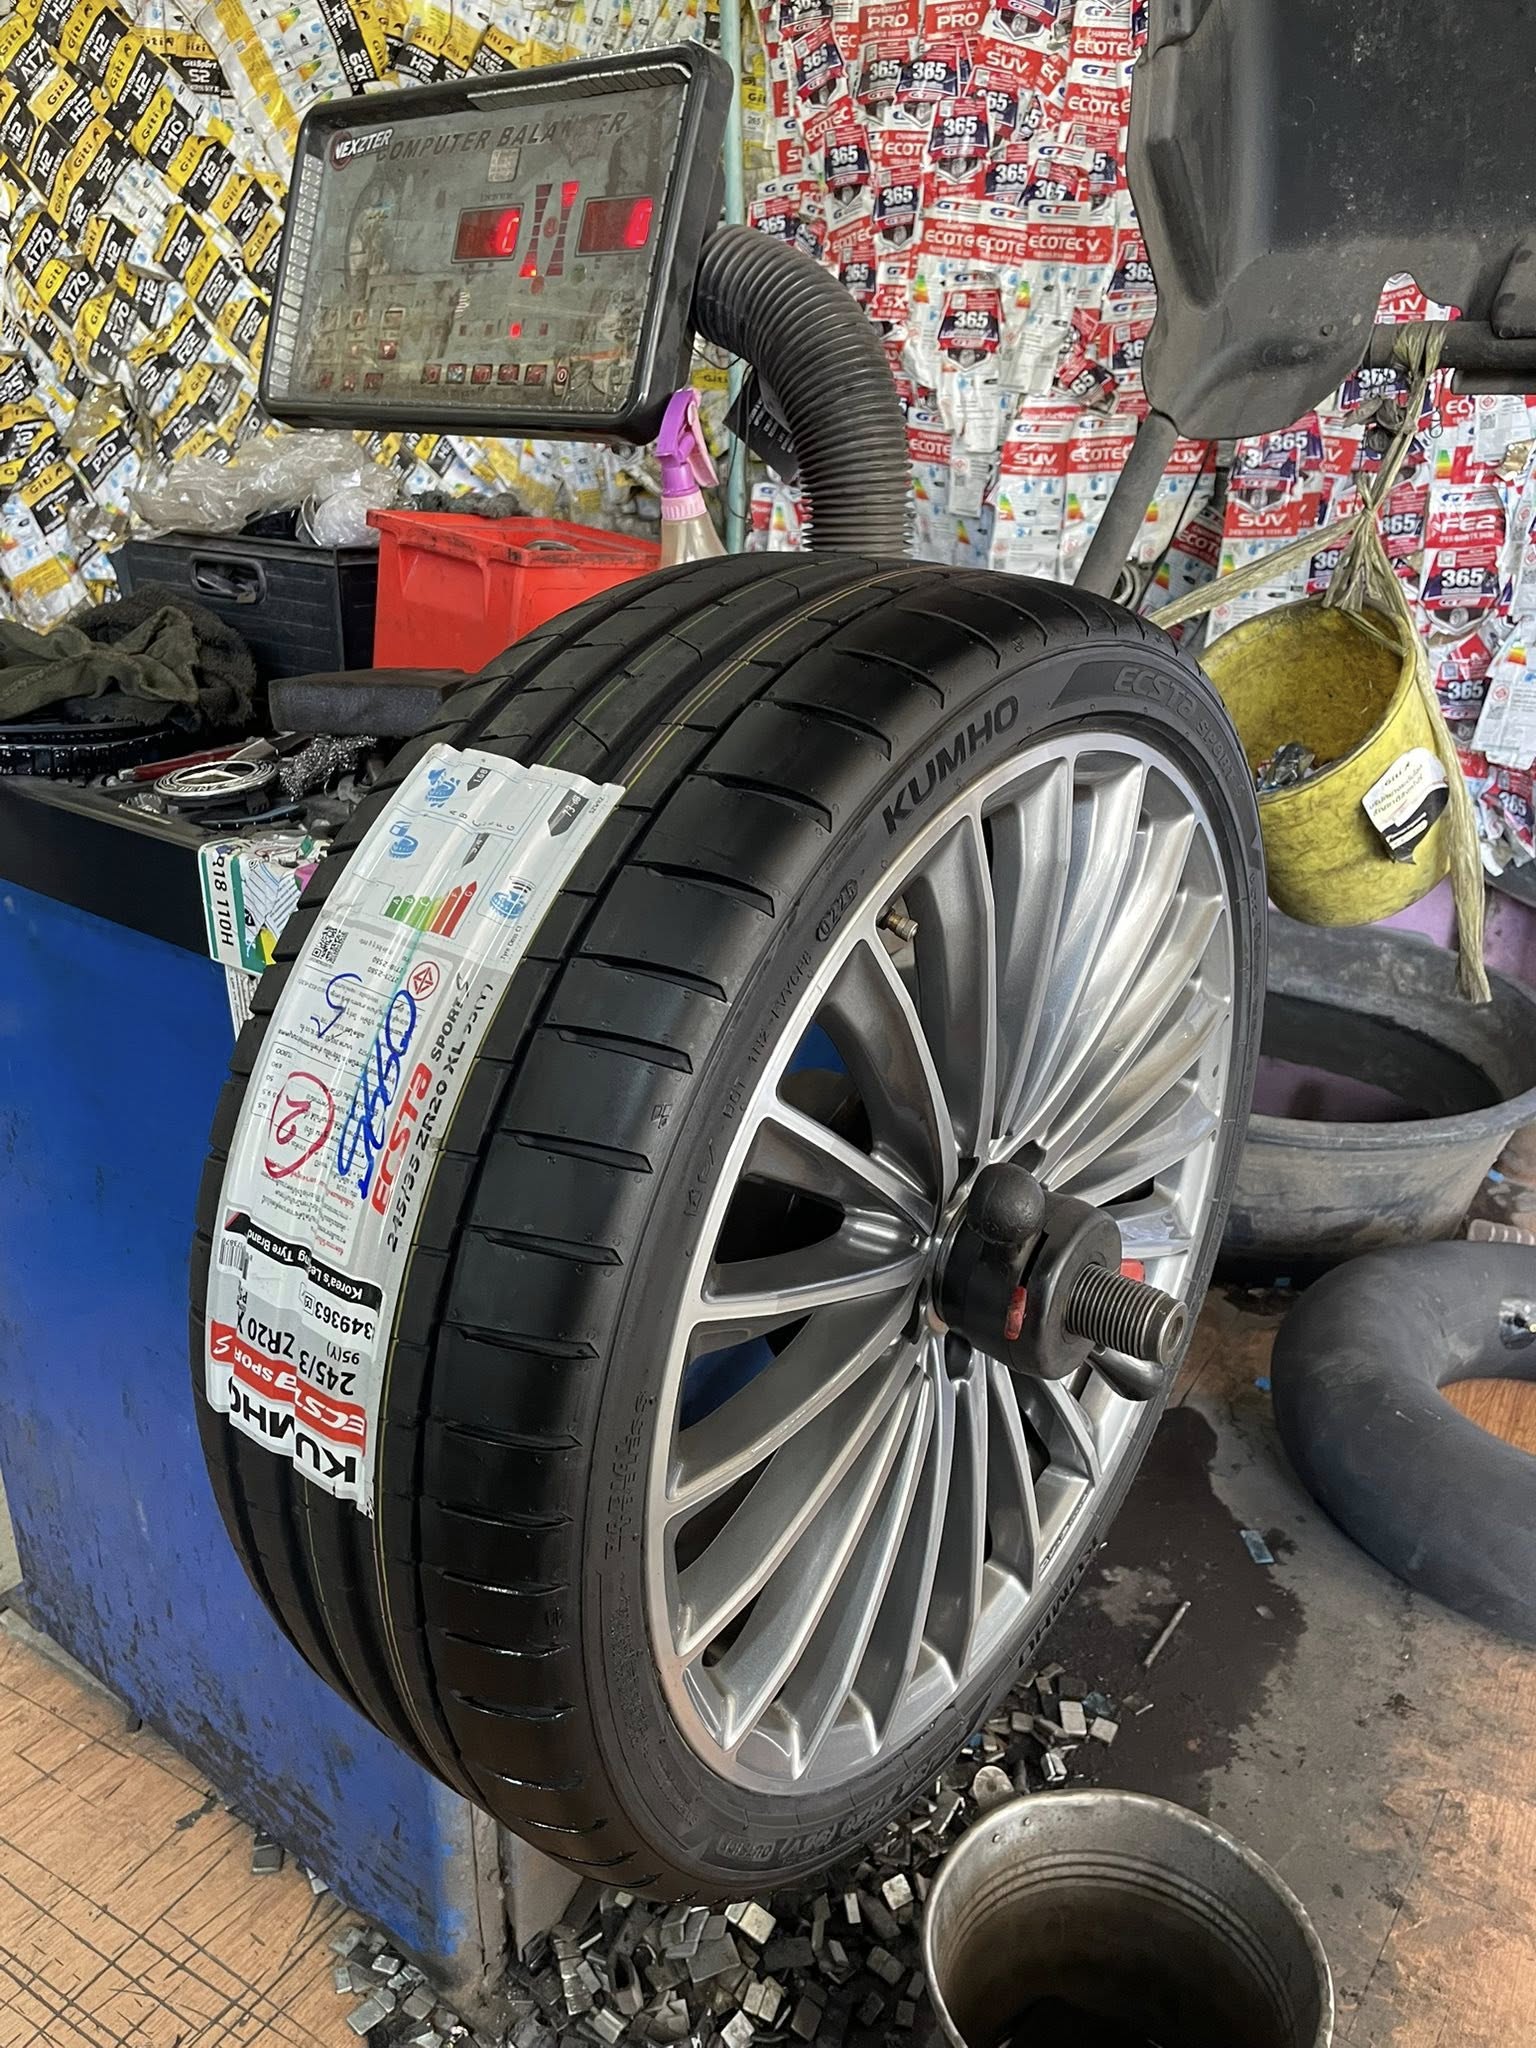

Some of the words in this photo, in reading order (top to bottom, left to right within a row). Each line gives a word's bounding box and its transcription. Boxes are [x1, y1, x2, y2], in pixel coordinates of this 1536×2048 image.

[330, 3, 349, 29] H2
[867, 13, 909, 29] PRO
[937, 13, 979, 29] PRO
[68, 20, 85, 49] Giti
[414, 31, 437, 48] Giti
[89, 33, 110, 63] H2
[110, 60, 126, 89] Giti
[410, 57, 436, 76] H2
[869, 60, 900, 81] 365
[912, 61, 947, 81] 365
[986, 50, 1030, 74] SUV
[132, 72, 151, 101] H2
[188, 69, 211, 84] S2
[47, 79, 69, 106] Giti
[69, 93, 94, 123] H2
[8, 121, 27, 148] H2
[142, 112, 159, 140] Giti
[805, 106, 850, 142] ECOTEC
[943, 117, 978, 137] 365
[161, 120, 185, 156] P10
[37, 150, 54, 178] H2
[73, 142, 93, 169] Giti
[180, 148, 197, 172] Giti
[830, 145, 859, 167] 365
[1039, 146, 1062, 157] GT
[97, 158, 115, 185] S2
[201, 161, 221, 187] H2
[996, 164, 1028, 184] 365
[222, 187, 239, 211] Giti
[882, 186, 914, 209] 365
[1034, 181, 1067, 201] 365
[71, 202, 88, 230] H2
[241, 201, 259, 225] S2
[990, 207, 1016, 219] GT
[1038, 204, 1062, 214] GT
[758, 215, 787, 235] 365
[25, 228, 54, 273] AT70
[105, 241, 122, 270] H2
[174, 236, 192, 262] H2
[249, 233, 266, 258] Giti
[1028, 236, 1085, 252] ECOTEC
[45, 264, 64, 290] Giti
[191, 263, 205, 287] Giti
[845, 264, 869, 282] 365
[60, 272, 91, 314] AT70
[142, 279, 159, 307] H2
[90, 297, 105, 326] Giti
[110, 301, 131, 346] AT70
[954, 311, 990, 329] 365
[174, 418, 193, 441] H2
[1016, 424, 1041, 433] GT
[1270, 431, 1308, 451] 365
[94, 442, 118, 473] P10
[1014, 453, 1057, 465] SUV
[1238, 513, 1288, 527] SUV
[1442, 514, 1497, 533] FE2
[1441, 568, 1486, 587] 365
[1448, 681, 1485, 700] 365
[882, 695, 1020, 835] KUMHO
[1499, 791, 1529, 817] 365
[216, 901, 235, 947] 110H
[430, 1000, 465, 1062] SPORT
[384, 1153, 421, 1254] 245/35
[415, 1080, 449, 1151] ZR20
[446, 1040, 467, 1075] XL
[246, 1227, 272, 1254] Brand
[271, 1241, 295, 1263] Tyre
[324, 1268, 364, 1301] Korea's
[247, 1320, 297, 1361] ZR20
[326, 1339, 361, 1366] 95(Y)
